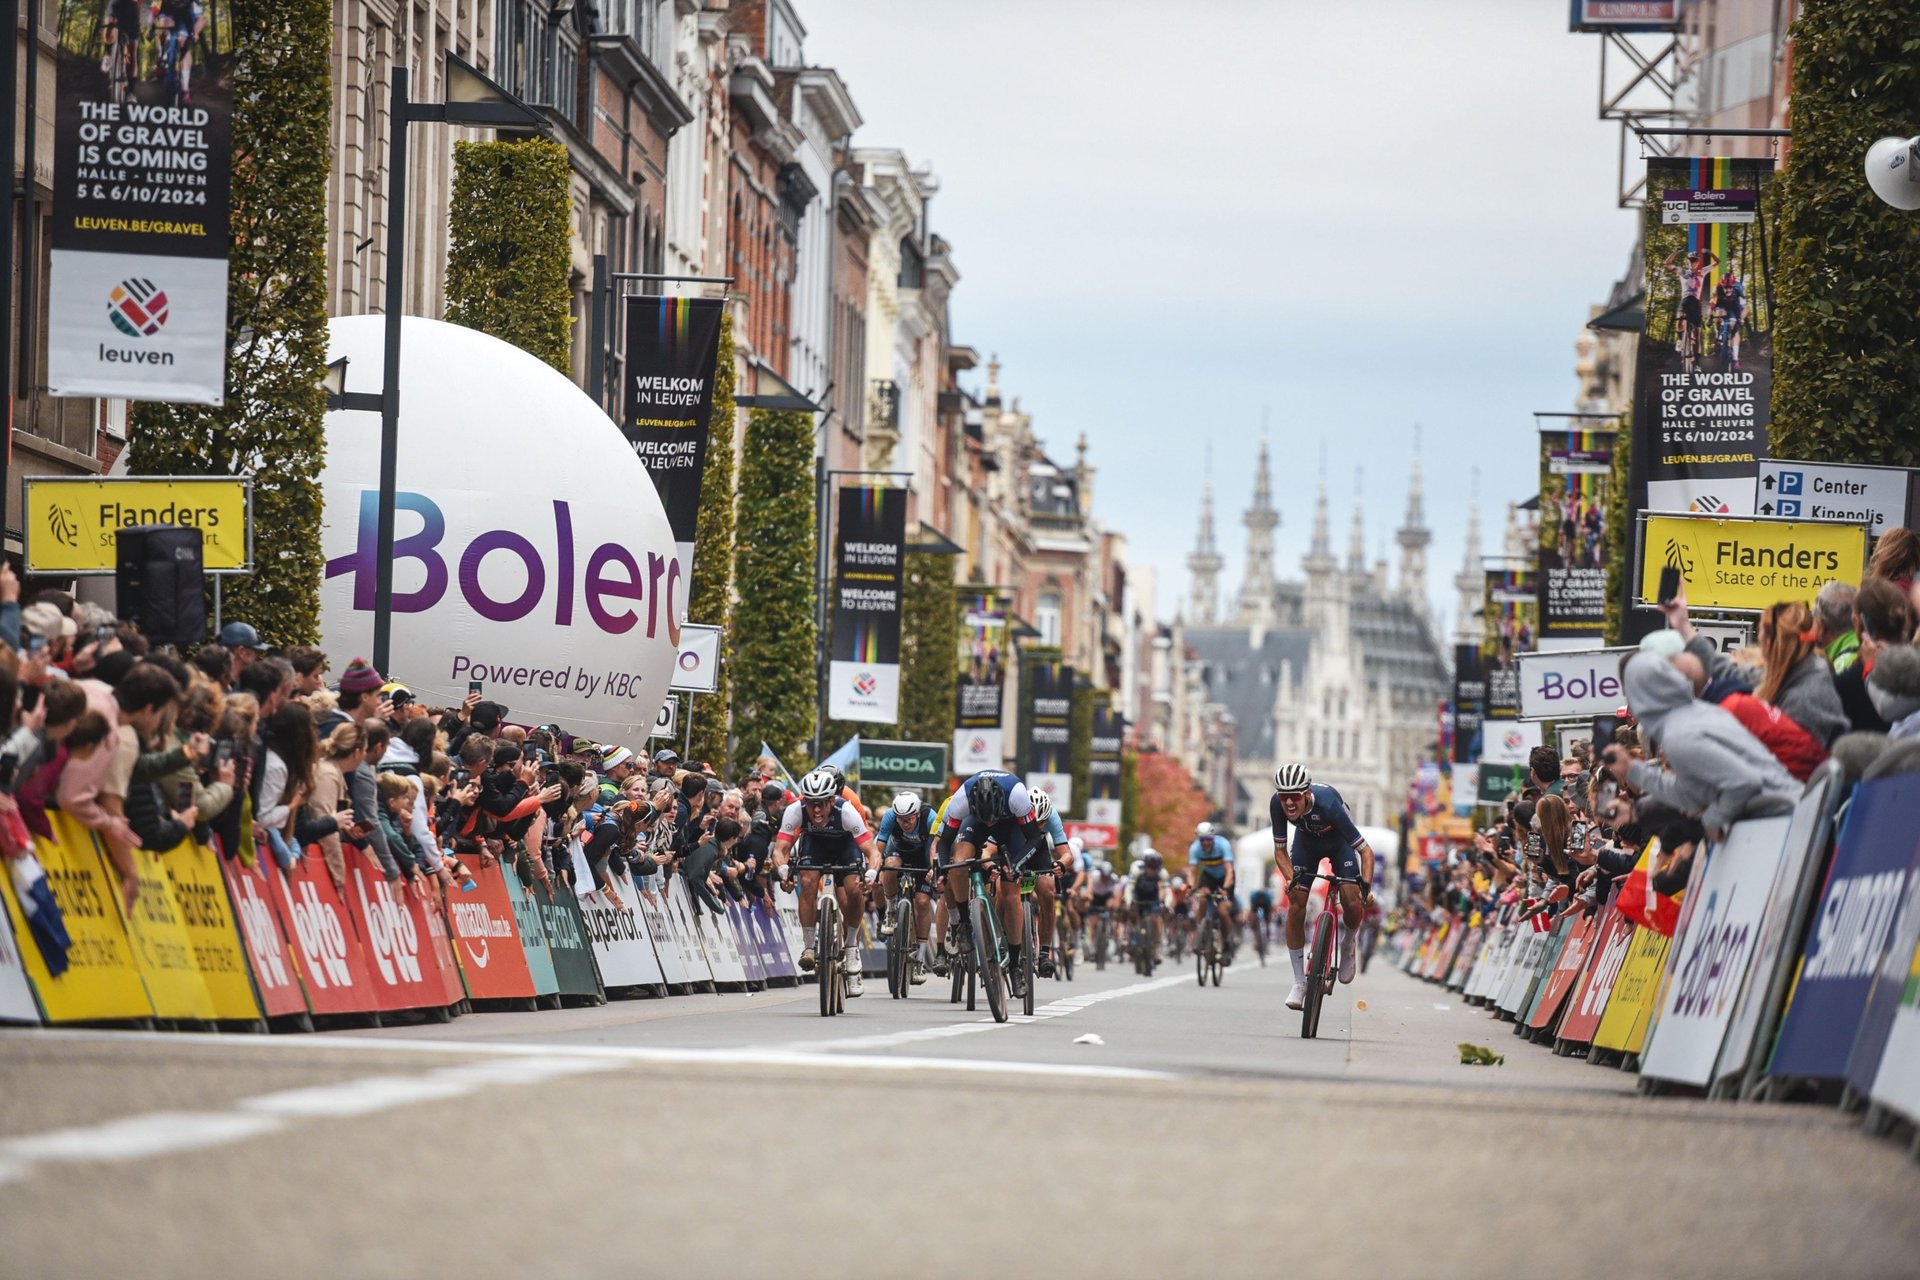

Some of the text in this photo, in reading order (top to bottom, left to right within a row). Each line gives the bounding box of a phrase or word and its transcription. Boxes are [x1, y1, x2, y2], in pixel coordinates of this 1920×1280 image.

[79, 101, 209, 127] THE WORLD
[79, 123, 209, 149] OF GRAVEL
[78, 146, 208, 171] IS COMING
[77, 168, 127, 182] HALLE
[146, 171, 207, 186] LEUVEN
[77, 184, 207, 206] 5 & 6/10/2024
[1693, 191, 1726, 200] Bolero
[1667, 202, 1687, 211] UCI
[75, 216, 207, 237] LEUVEN.BE/GRAVEL
[99, 343, 174, 366] leuven
[636, 376, 703, 392] WELKOM
[1661, 373, 1753, 386] THE WORLD
[637, 391, 701, 406] IN LEUVEN
[1661, 388, 1754, 402] OF GRAVEL
[1662, 403, 1754, 418] IS COMING
[1662, 420, 1696, 429] HALLE
[1710, 419, 1754, 428] LEUVEN
[1662, 430, 1754, 442] 5 & 6/10/2024
[632, 440, 697, 455] WELCOME
[651, 456, 694, 469] LEUVEN
[1662, 453, 1755, 465] LEUVEN.BE/GRAVEL
[1814, 477, 1868, 495] Center
[100, 502, 219, 528] Flanders
[844, 542, 897, 555] WELKOM
[1716, 541, 1838, 571] Flanders
[326, 489, 682, 648] Bolero
[844, 554, 896, 566] IN LEUVEN
[1549, 569, 1567, 578] THE
[1715, 570, 1755, 586] State
[1760, 572, 1778, 587] of
[1782, 574, 1808, 588] the
[1549, 579, 1563, 589] OF
[841, 588, 896, 601] WELCOME
[1549, 589, 1559, 599] IS
[841, 599, 896, 612] TO LEUVEN
[452, 655, 642, 699] Powered by KBC
[1537, 668, 1620, 700] Bole
[278, 867, 353, 988] lotto
[353, 868, 423, 986] lotto
[542, 904, 584, 949] SKODA
[581, 904, 643, 951] superior.
[1673, 882, 1749, 1018] Bolero
